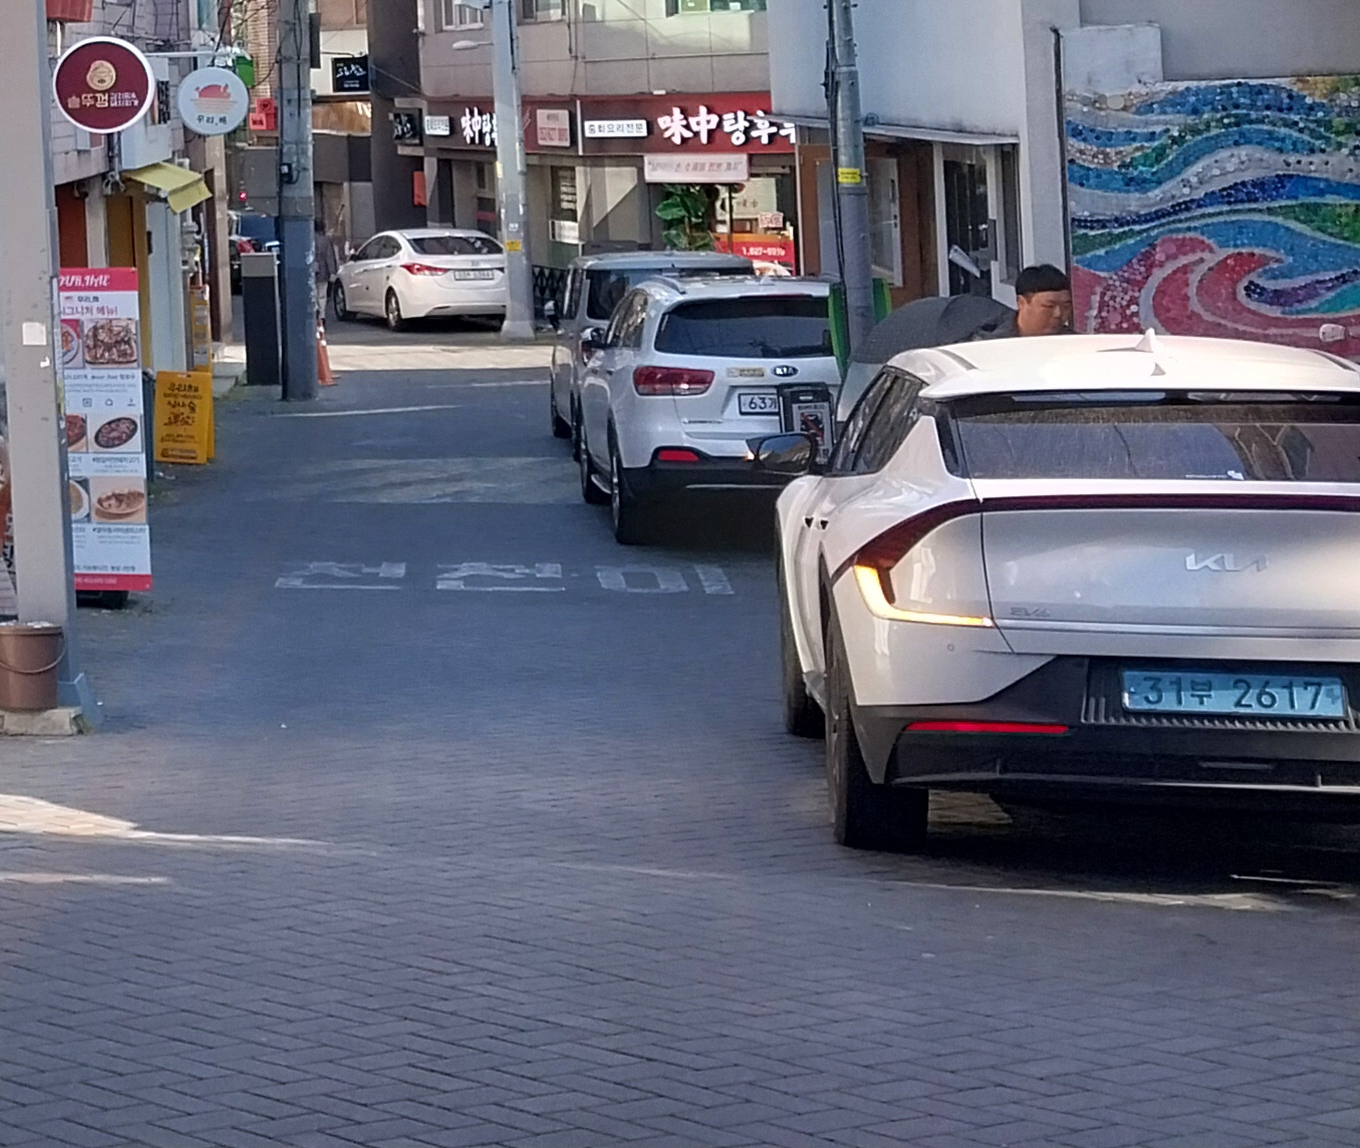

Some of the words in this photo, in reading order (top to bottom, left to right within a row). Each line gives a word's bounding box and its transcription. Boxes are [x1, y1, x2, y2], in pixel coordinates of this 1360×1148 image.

[775, 367, 794, 375] KIA
[1010, 607, 1050, 618] EV6
[1143, 675, 1212, 706] 31부
[1234, 677, 1325, 711] 2617
